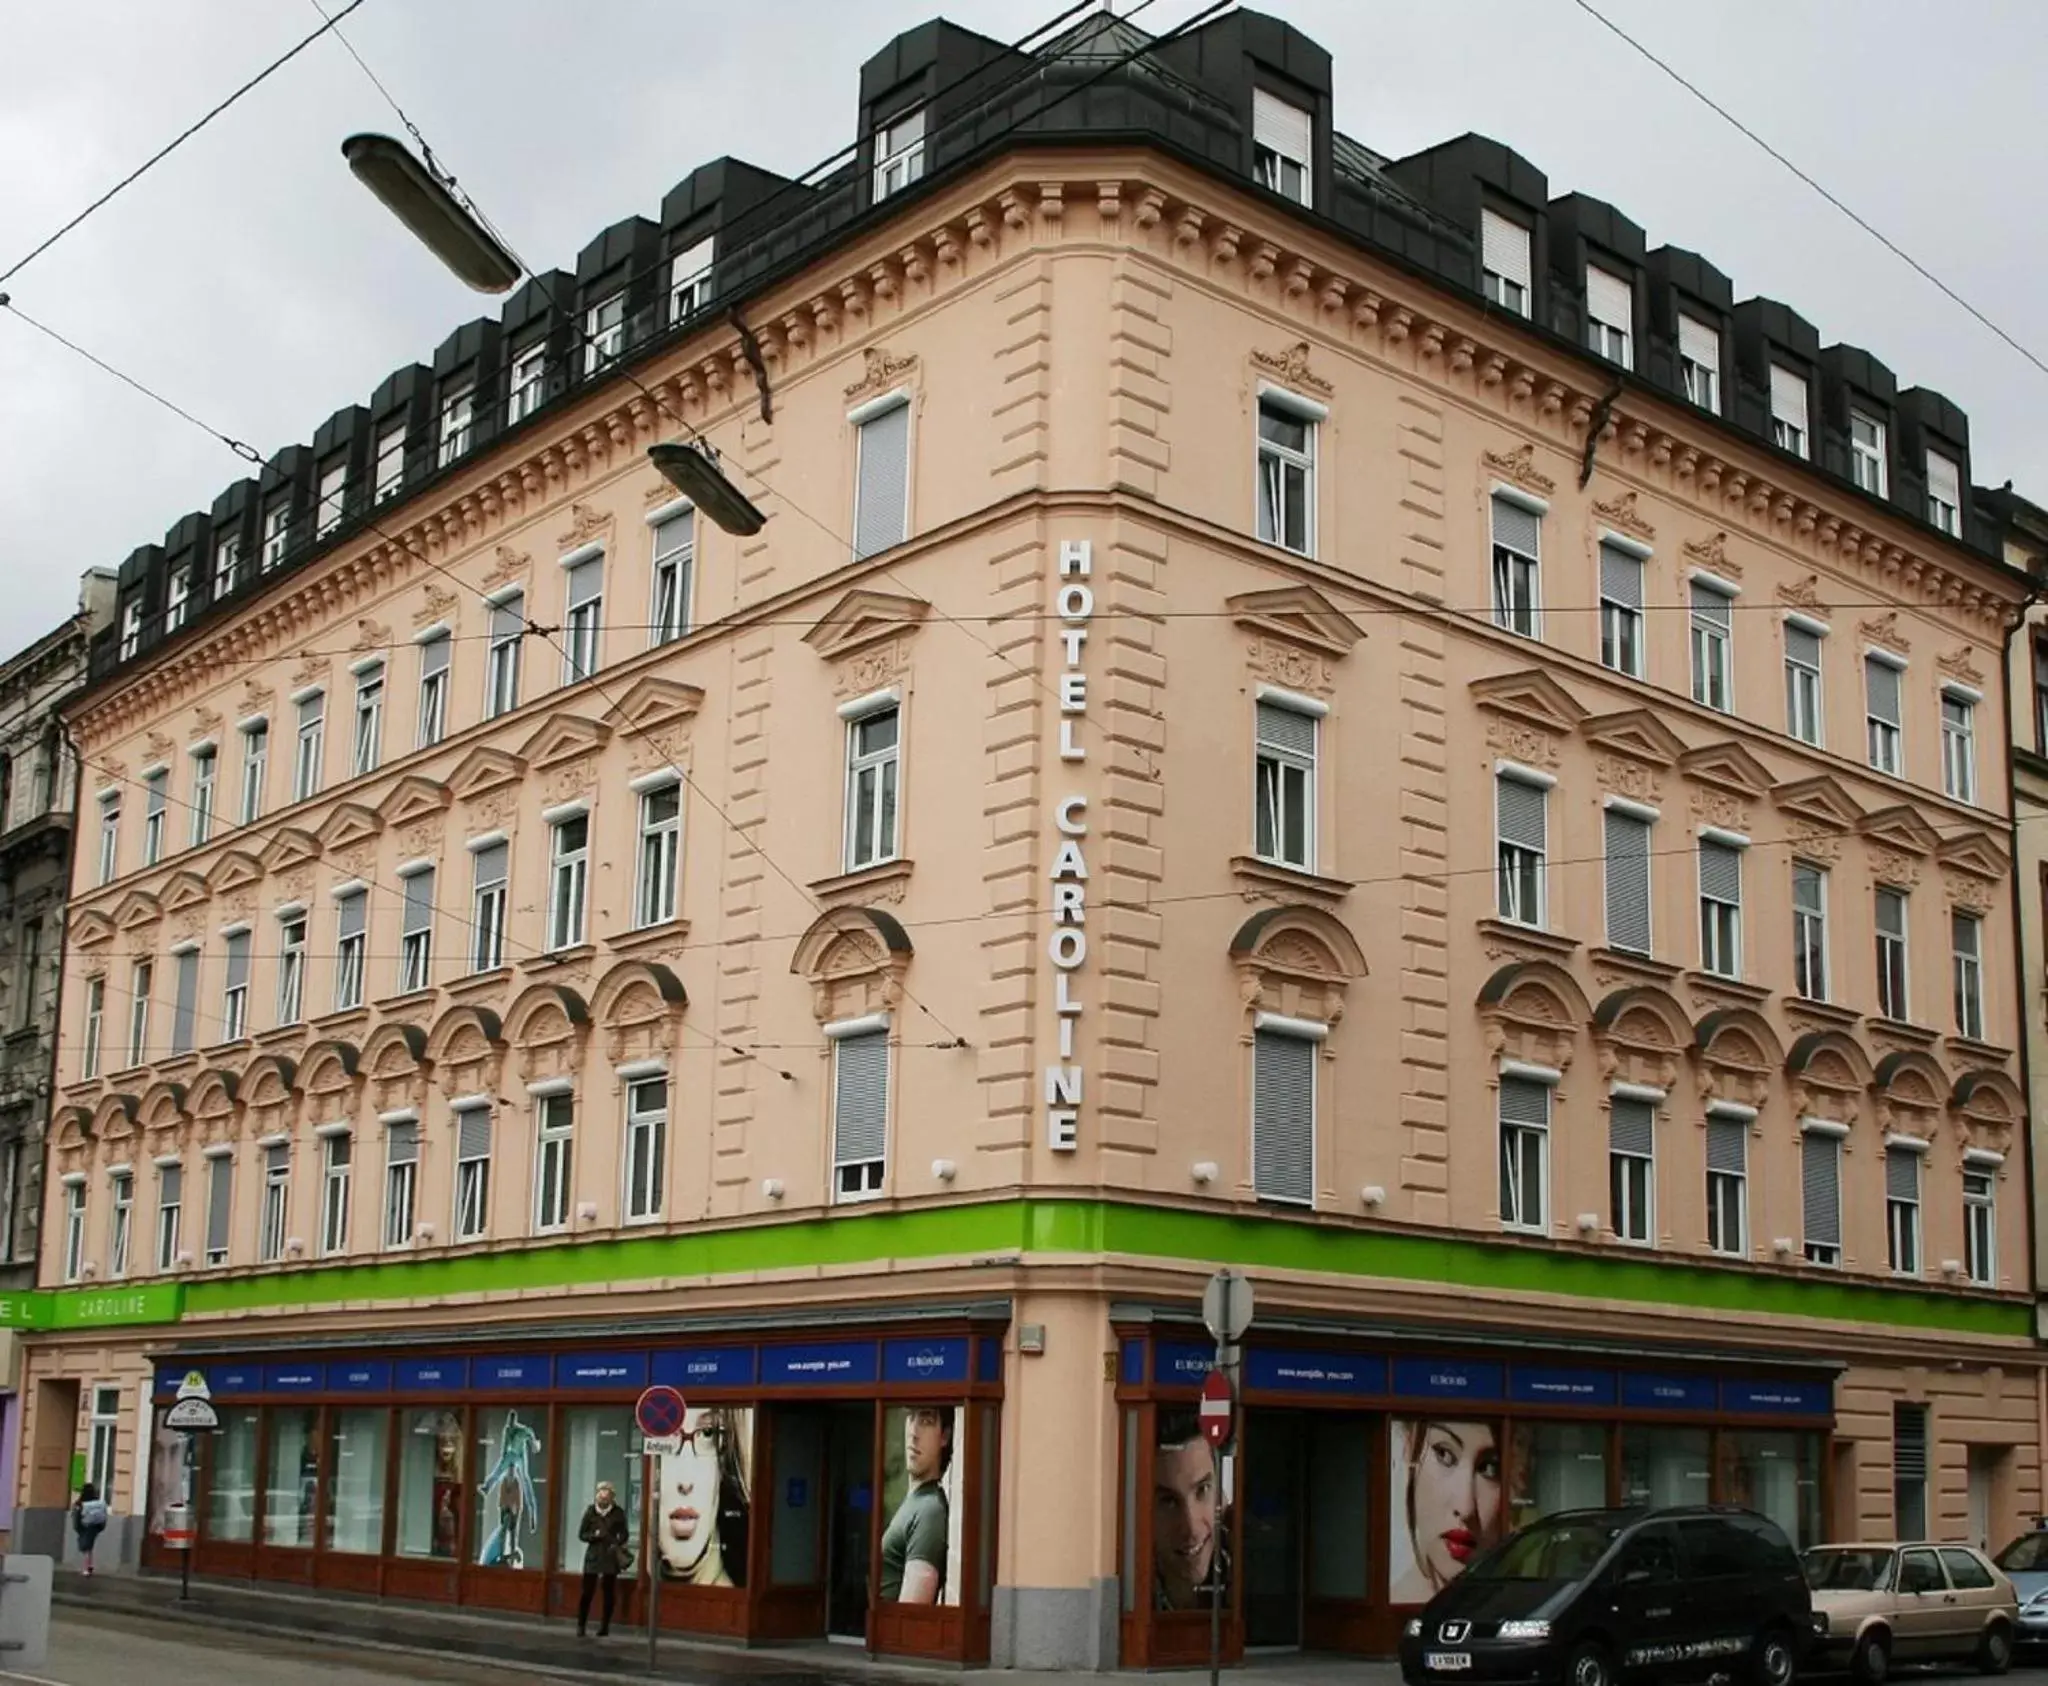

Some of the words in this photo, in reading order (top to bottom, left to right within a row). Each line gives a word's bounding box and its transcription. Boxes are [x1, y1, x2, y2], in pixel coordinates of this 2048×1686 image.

[1057, 540, 1094, 761] HOTEL
[1047, 796, 1089, 1152] CAROLINE
[78, 1295, 145, 1317] CAROLINE
[647, 1441, 674, 1454] Anfang
